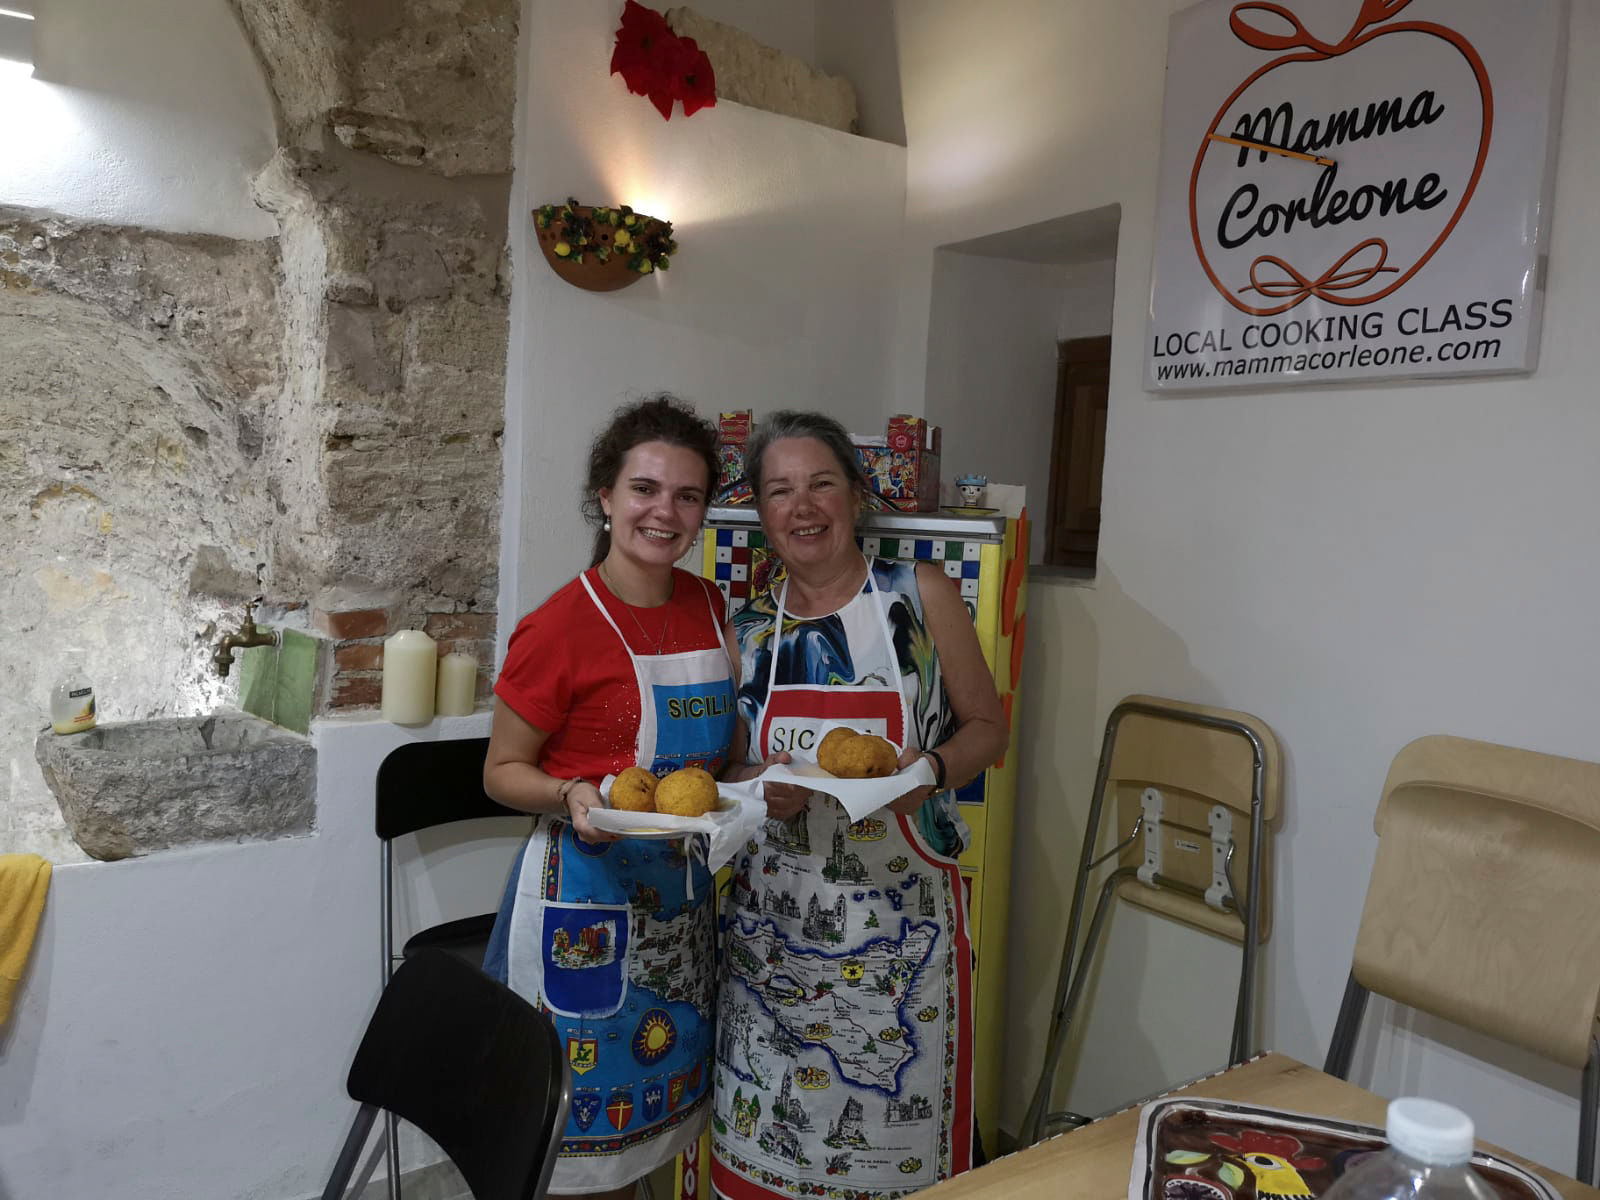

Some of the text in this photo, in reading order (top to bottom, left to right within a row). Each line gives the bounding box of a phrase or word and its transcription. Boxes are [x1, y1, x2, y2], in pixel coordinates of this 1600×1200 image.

[1233, 89, 1445, 167] Mamma
[1218, 162, 1448, 249] Corleone
[1154, 299, 1513, 357] LOCAL COOKING CLASS
[1157, 337, 1501, 381] www.mammacorleone.com
